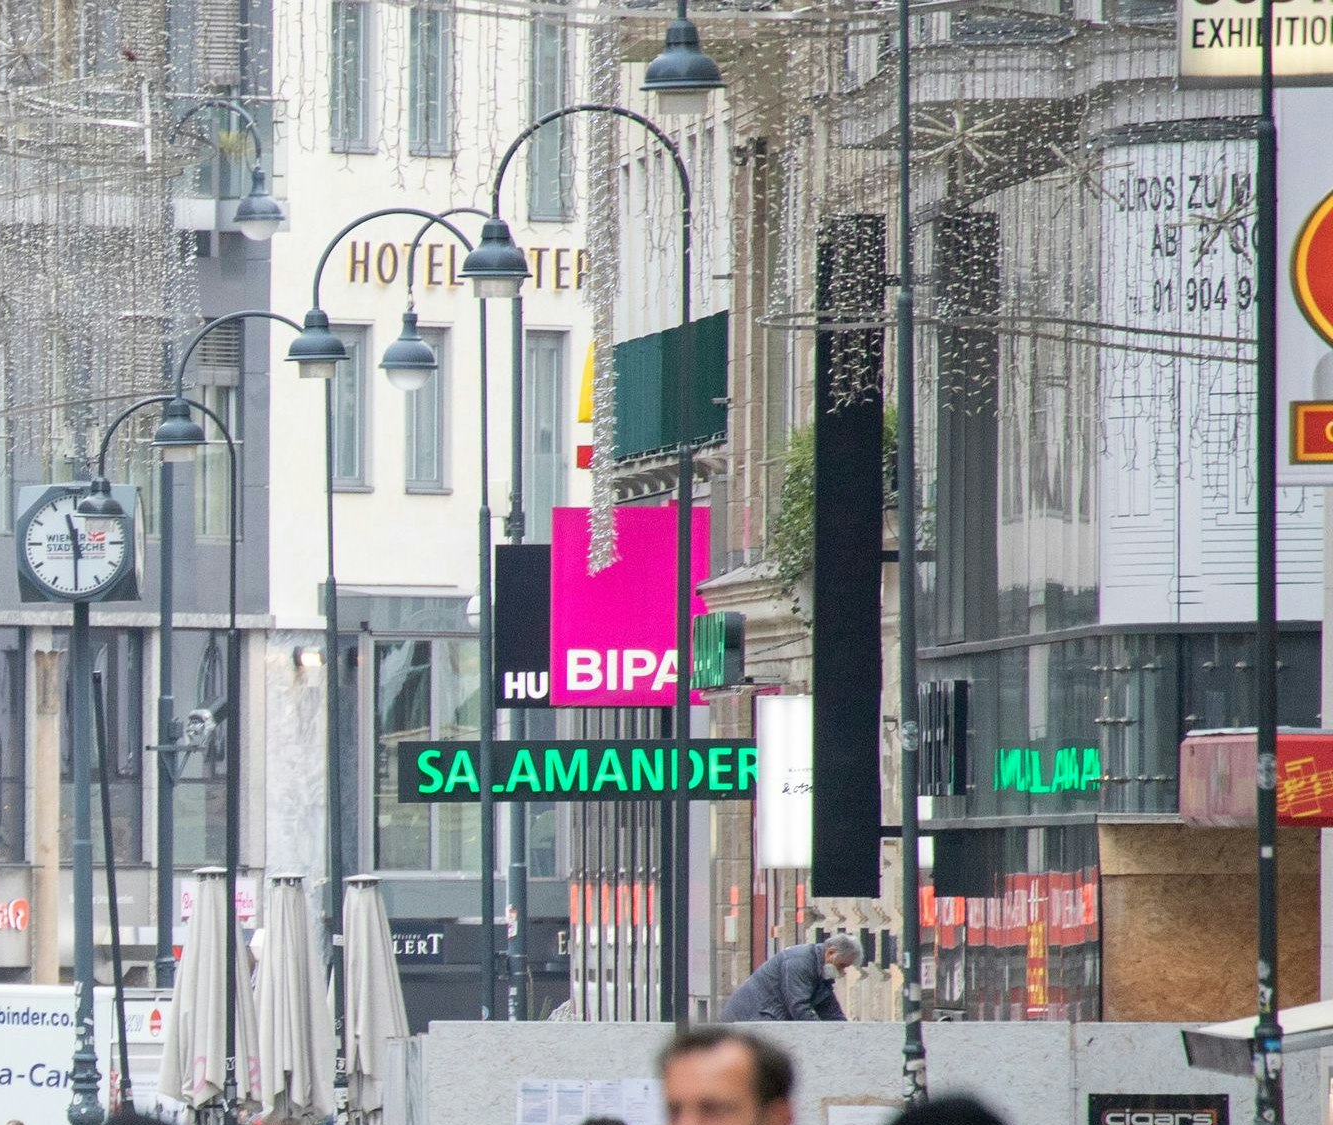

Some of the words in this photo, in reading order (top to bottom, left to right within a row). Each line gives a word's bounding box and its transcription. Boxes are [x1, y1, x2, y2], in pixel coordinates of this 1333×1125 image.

[1192, 16, 1333, 48] EXHIITIO
[46, 534, 86, 543] WIER
[566, 648, 679, 692] BIPA
[417, 747, 759, 794] SAAMANDER
